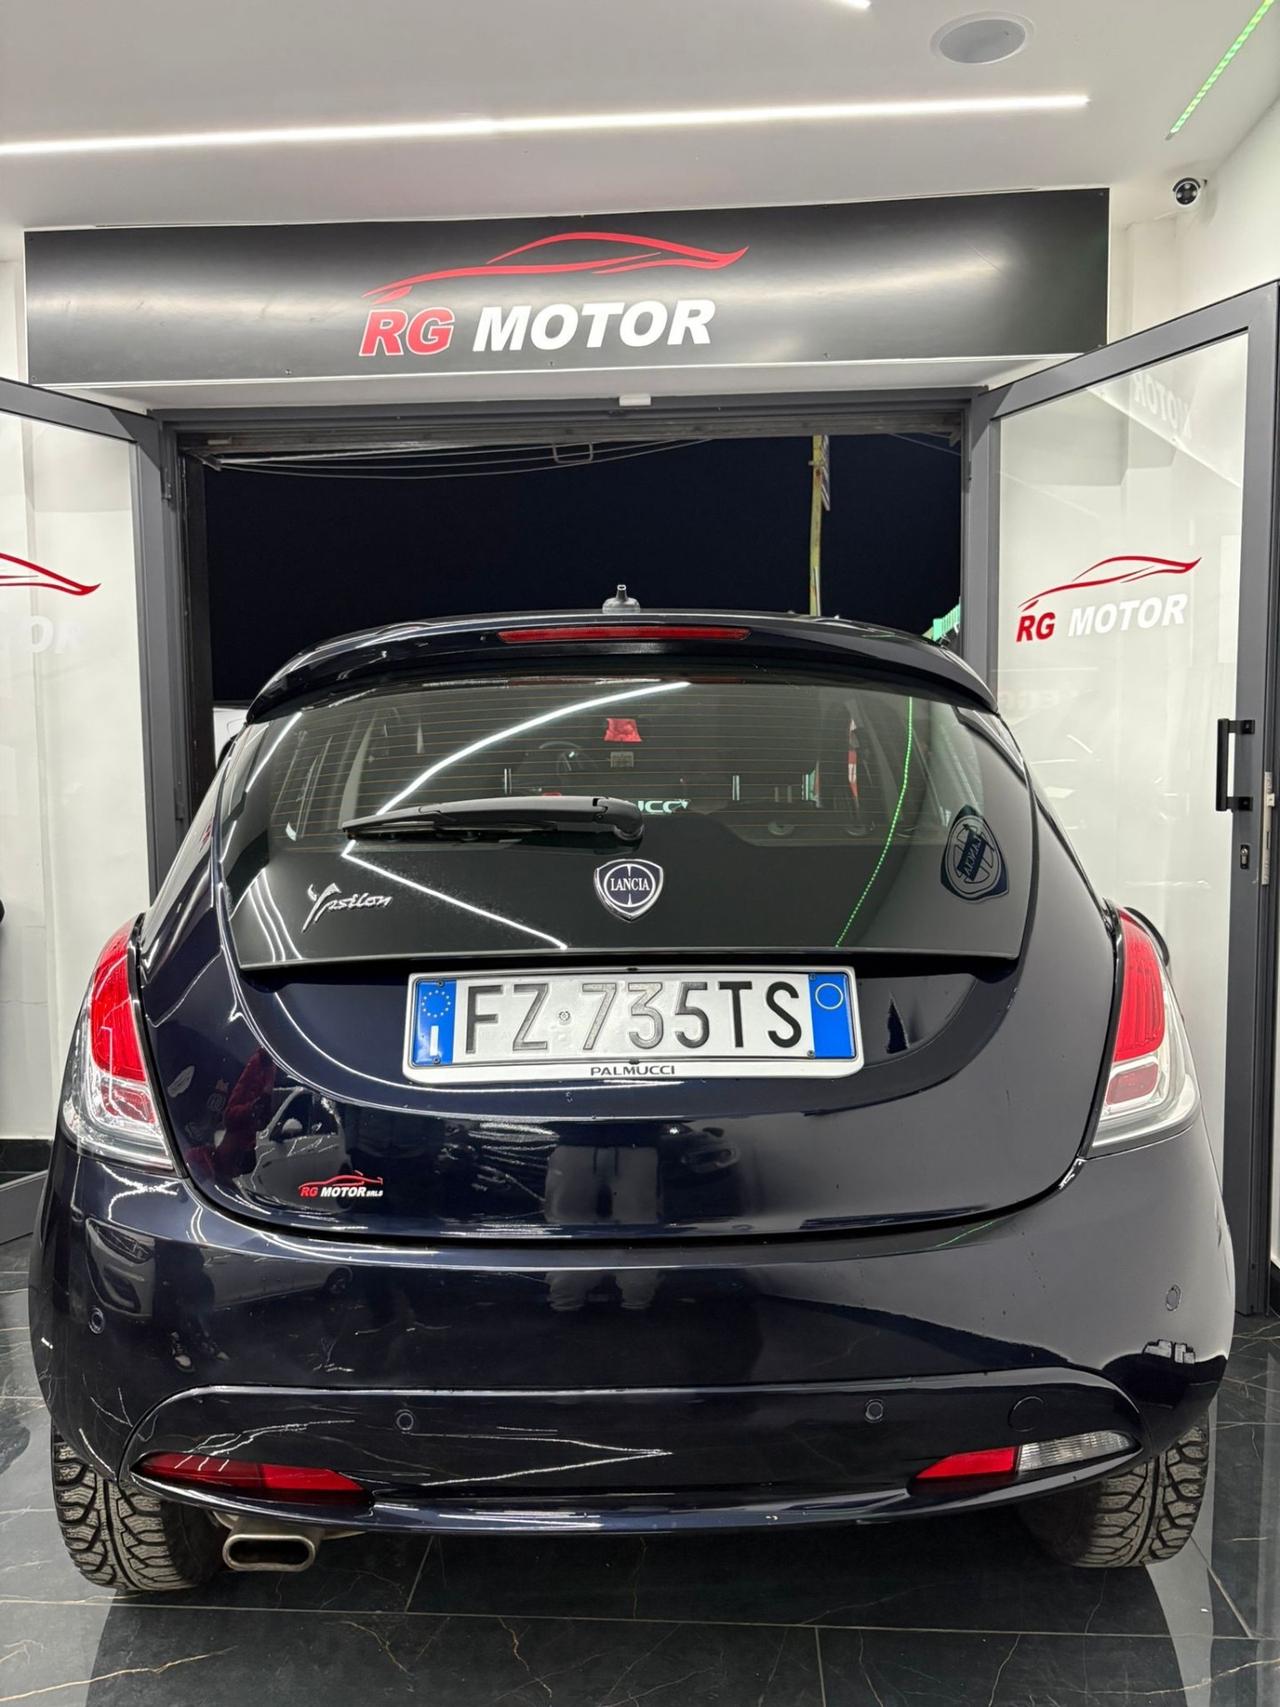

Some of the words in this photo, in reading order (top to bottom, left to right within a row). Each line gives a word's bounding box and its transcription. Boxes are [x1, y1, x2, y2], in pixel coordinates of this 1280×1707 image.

[358, 307, 456, 357] RG
[472, 300, 716, 352] MOTOR
[1016, 611, 1056, 643] RG
[1067, 593, 1188, 638] MOTOR
[610, 877, 651, 891] LANCIA
[301, 882, 393, 933] Ypsilon
[590, 1065, 676, 1077] PALMUCCI
[300, 1187, 318, 1197] RG
[320, 1187, 366, 1197] MOTOR
